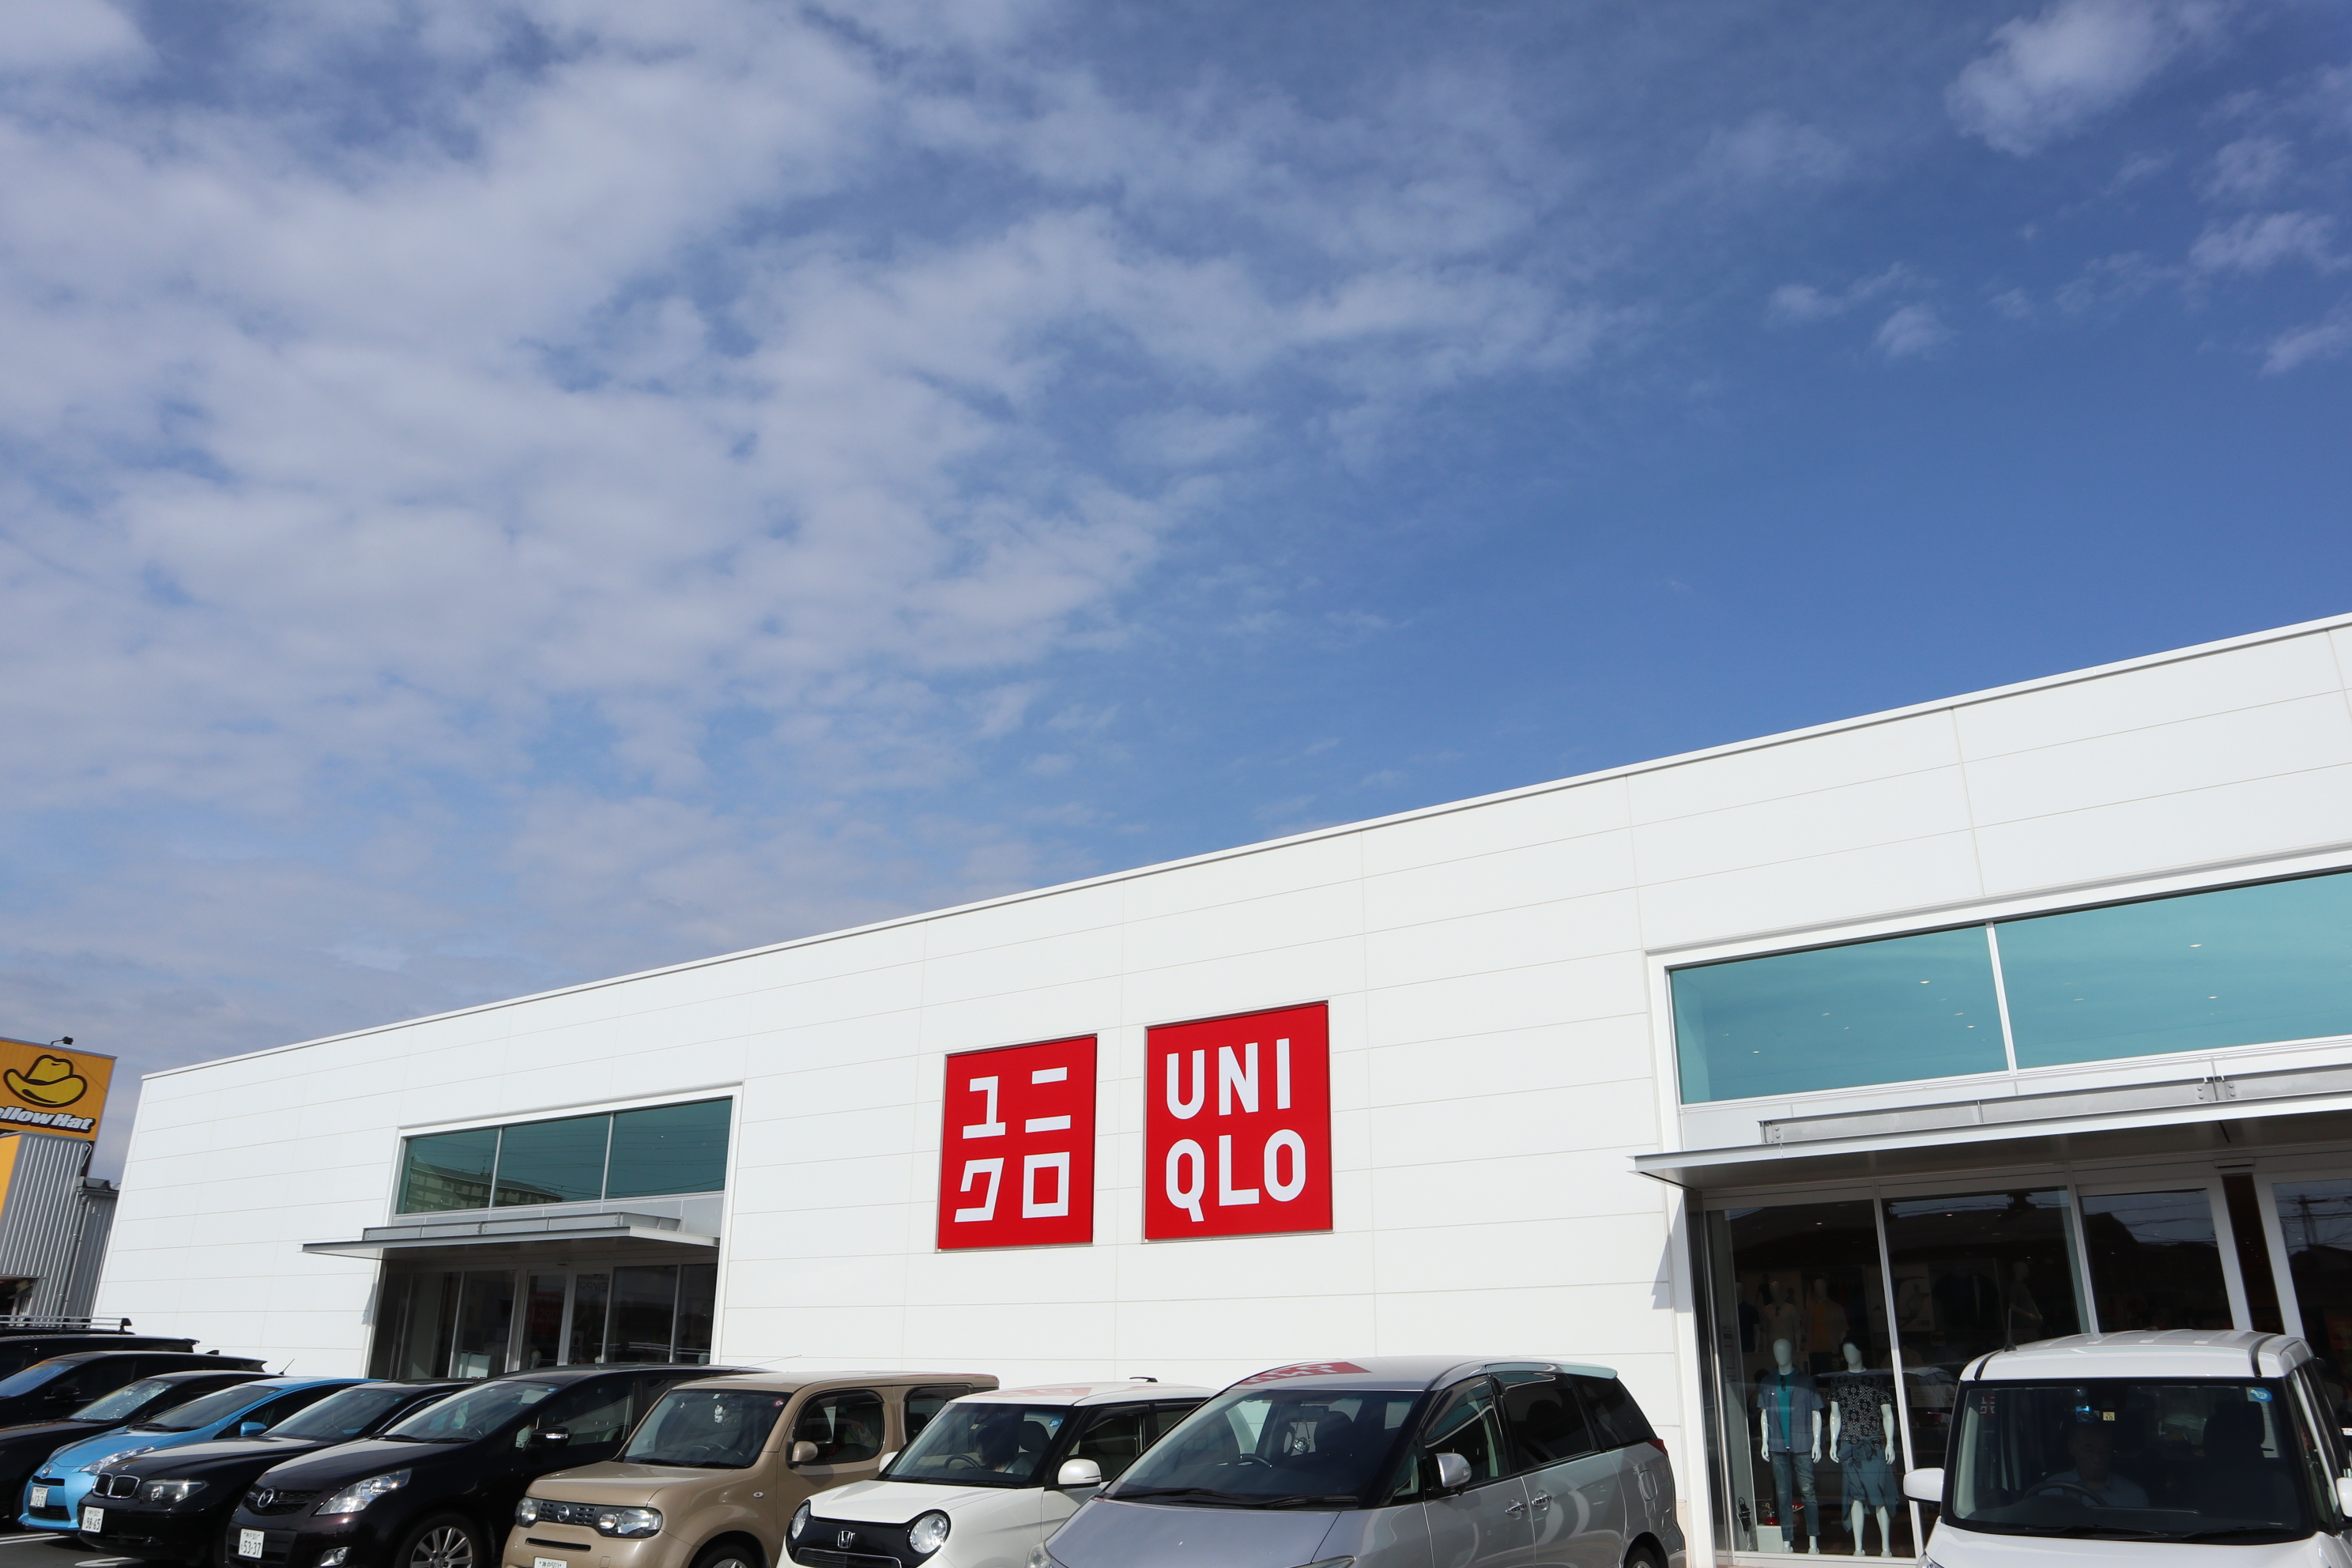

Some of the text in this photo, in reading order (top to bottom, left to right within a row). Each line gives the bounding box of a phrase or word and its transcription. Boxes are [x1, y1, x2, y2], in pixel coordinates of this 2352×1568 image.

[962, 1066, 1072, 1140] ユニ
[1166, 1037, 1291, 1121] UNI
[953, 1151, 1071, 1223] クロ
[1165, 1129, 1307, 1223] QLO
[243, 1540, 262, 1556] 53-37
